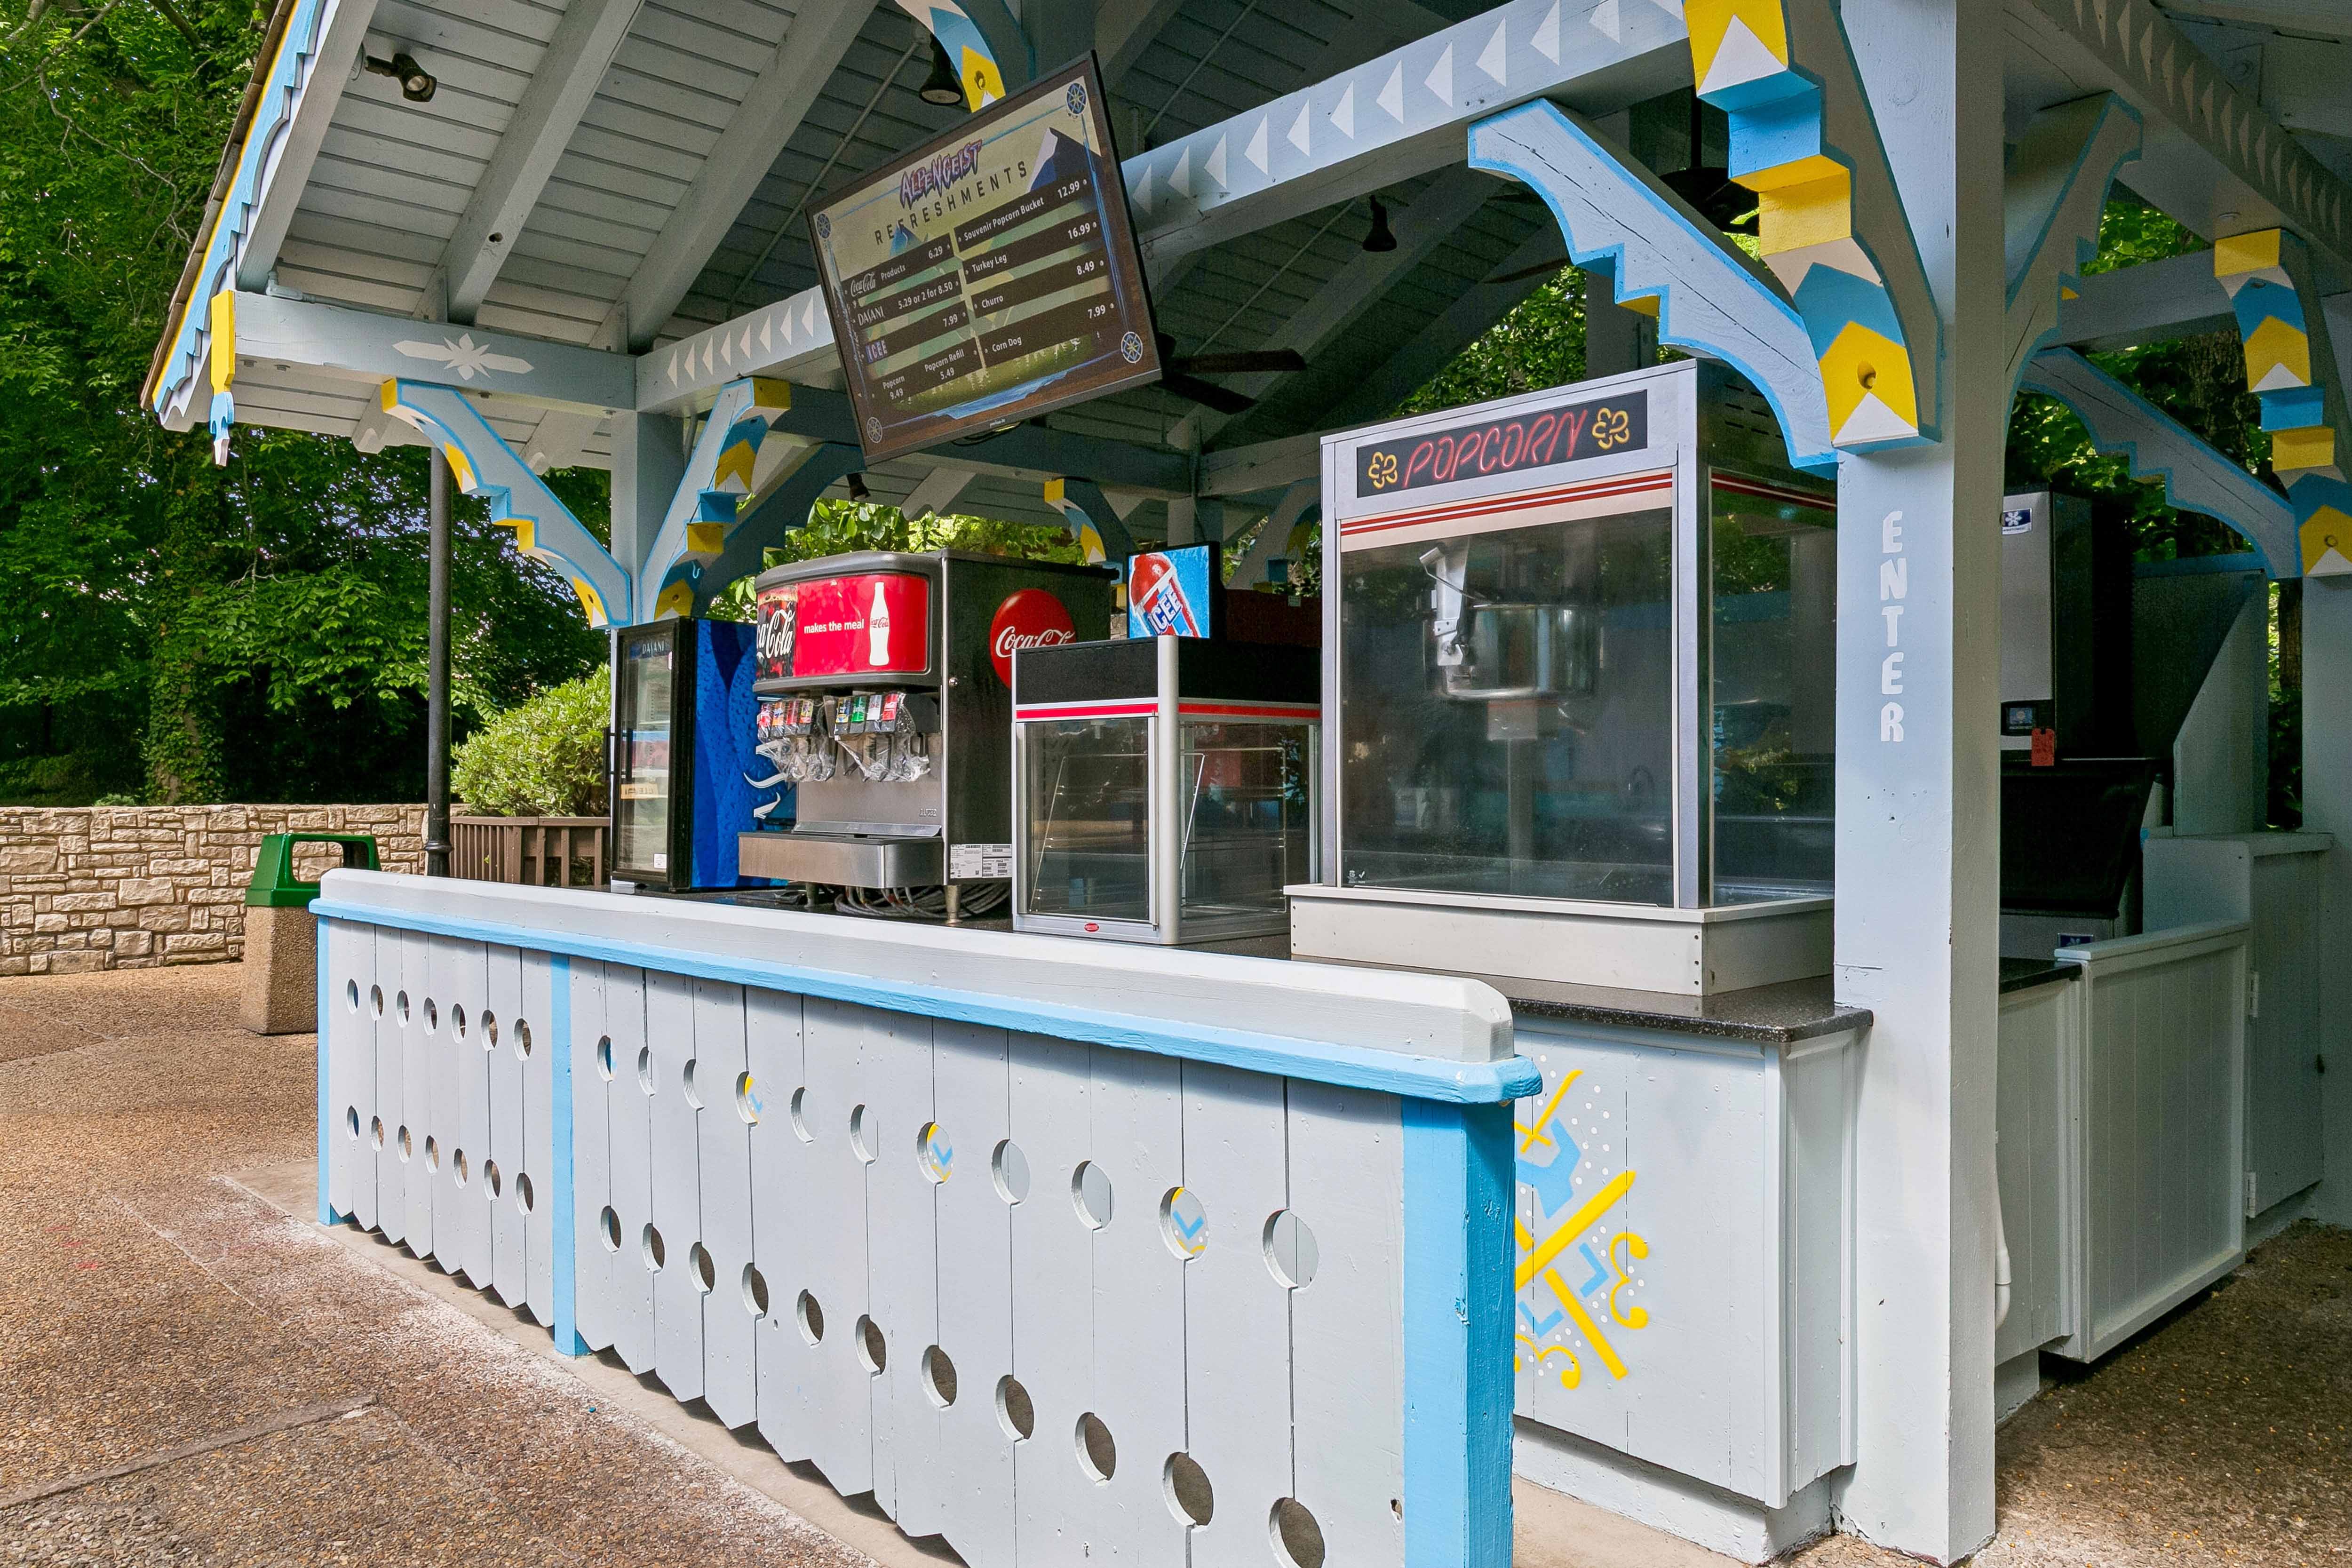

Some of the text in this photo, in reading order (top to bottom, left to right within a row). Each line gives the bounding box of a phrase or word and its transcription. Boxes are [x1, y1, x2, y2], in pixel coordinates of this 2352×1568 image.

[900, 139, 983, 210] ALPENGEIST
[874, 160, 1027, 245] REFRESHMENTS
[964, 180, 1080, 241] Souvenir Popcorn Bucket 12.99
[881, 265, 906, 281] Products
[928, 246, 943, 259] 6.29
[972, 222, 1090, 273] Turkey Leg 16.99
[858, 281, 953, 326] DASANI 5.29 or 2 for 8.50
[982, 261, 1095, 309] Churro 8.49
[866, 314, 958, 363] ICEE 7.99
[992, 304, 1106, 353] Corn Dog 7.99
[882, 376, 905, 390] Popcorn
[925, 349, 964, 372] Popcorn Refill
[940, 367, 954, 380] 5.49
[890, 388, 904, 400] 9.49
[1402, 409, 1589, 489] POPCORN
[804, 619, 865, 634] makes the meal
[1148, 588, 1182, 635] ICEE
[1881, 510, 1907, 742] ENTER
[643, 640, 664, 656] DASANI
